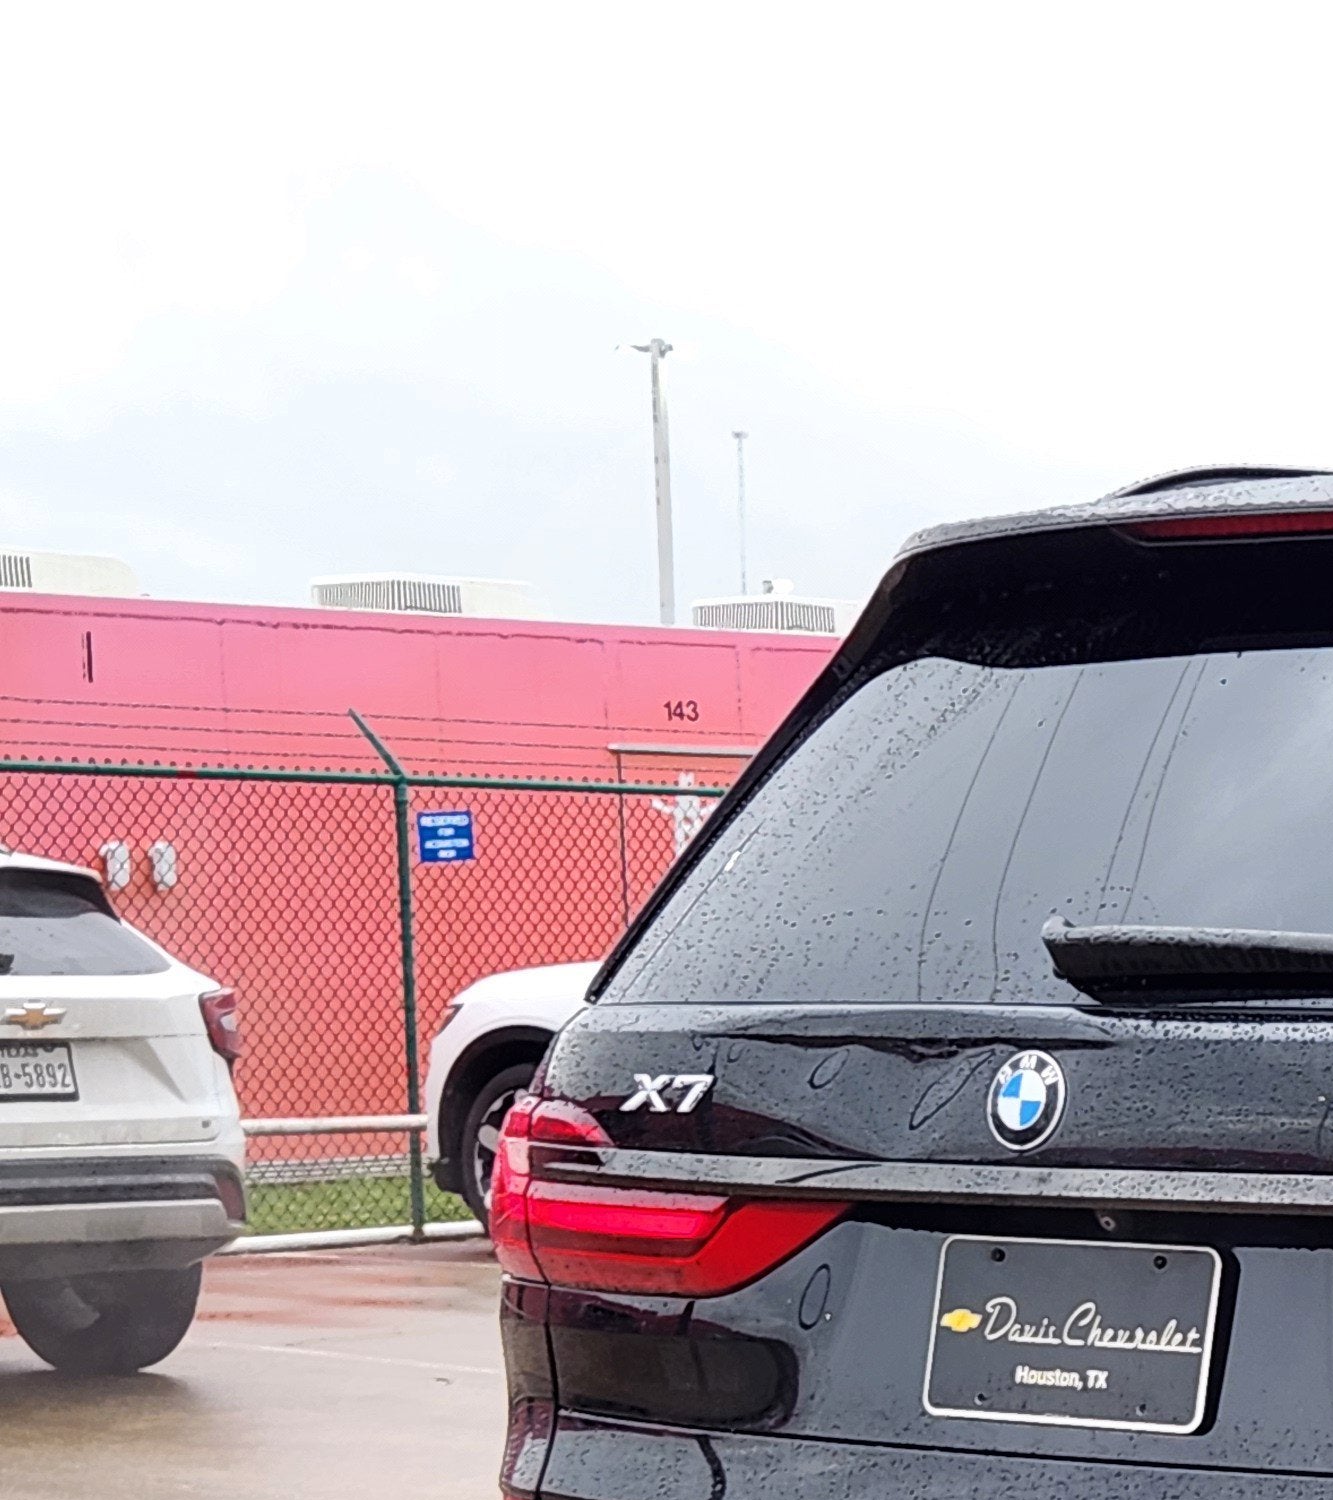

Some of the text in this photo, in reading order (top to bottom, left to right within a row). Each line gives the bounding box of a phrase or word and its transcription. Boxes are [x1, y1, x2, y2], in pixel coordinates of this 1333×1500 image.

[663, 700, 699, 722] 143
[998, 1054, 1060, 1086] BMW
[619, 1073, 715, 1113] X7
[983, 1296, 1203, 1353] Davis Chevrolet
[1014, 1365, 1109, 1391] Houston, TX
